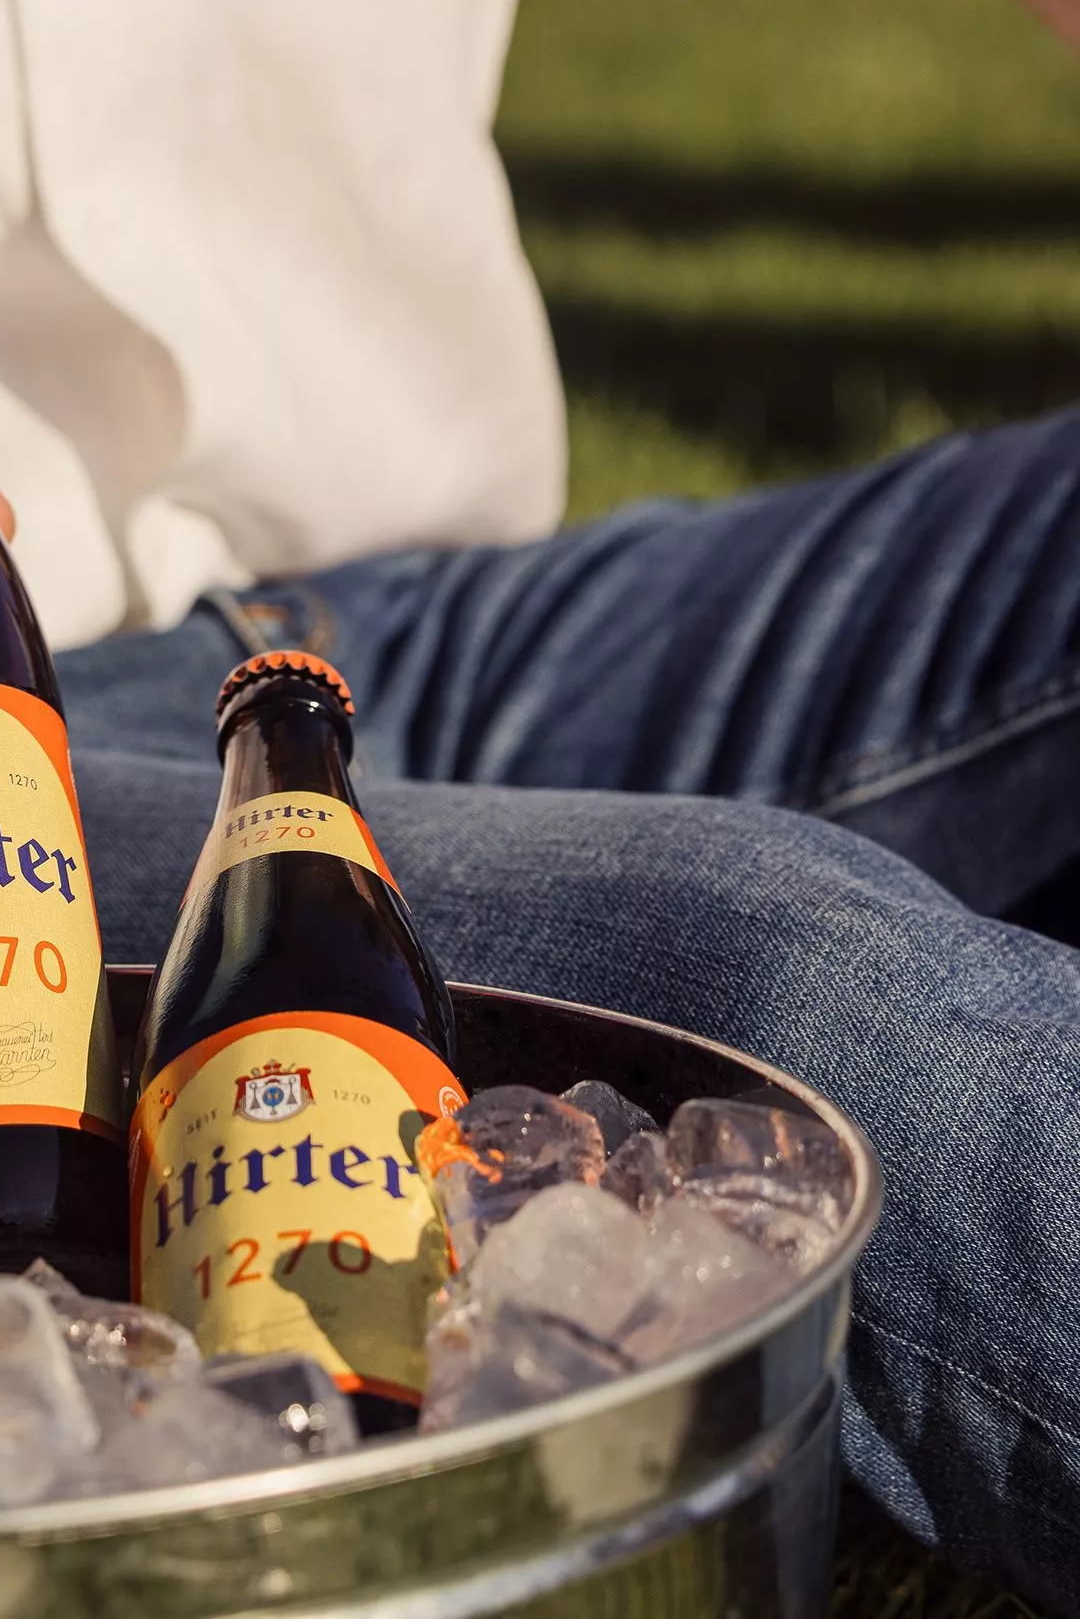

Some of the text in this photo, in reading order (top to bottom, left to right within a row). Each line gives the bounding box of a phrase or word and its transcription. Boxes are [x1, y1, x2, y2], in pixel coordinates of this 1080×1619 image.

[8, 773, 39, 792] 1270
[224, 804, 334, 839] Hirter
[239, 826, 316, 849] 1270
[333, 1089, 371, 1106] 1270
[153, 1132, 420, 1249] Hirter
[192, 1229, 373, 1301] 1270
